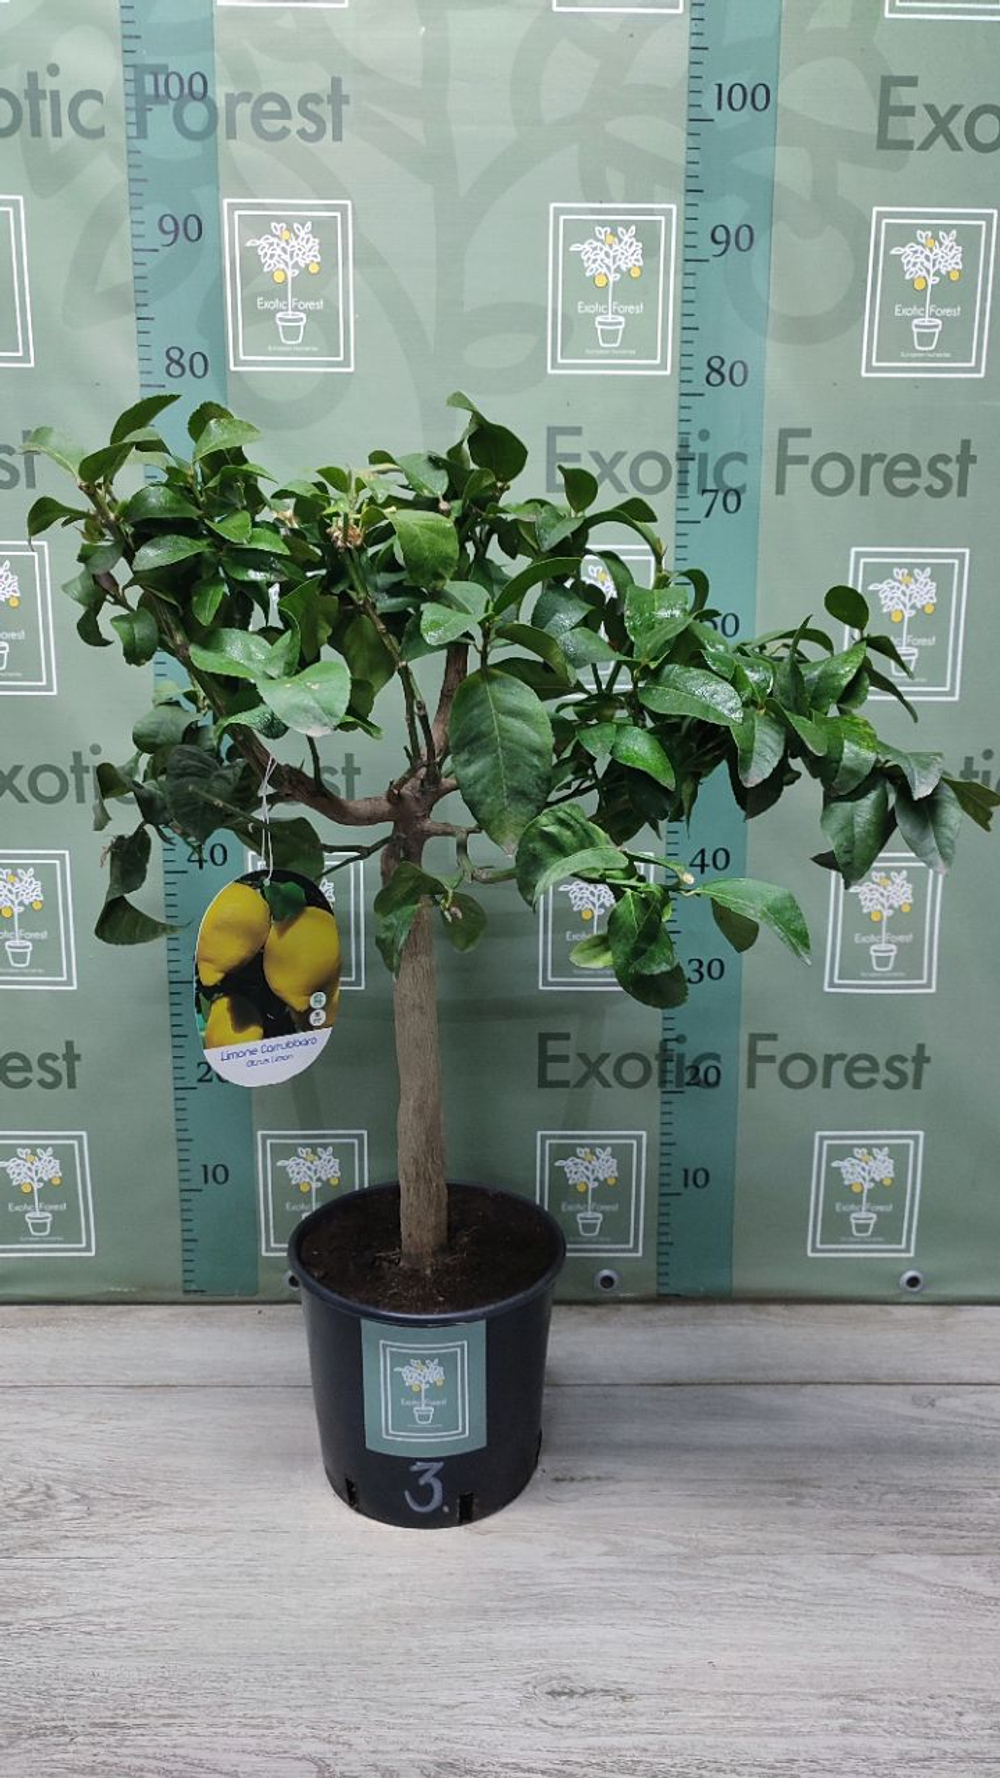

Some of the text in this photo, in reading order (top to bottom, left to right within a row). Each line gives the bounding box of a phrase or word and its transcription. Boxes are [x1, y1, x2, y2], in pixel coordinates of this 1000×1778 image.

[151, 71, 208, 101] 100
[714, 82, 771, 112] 100
[132, 63, 350, 142] Forest
[876, 75, 1000, 153] Exo
[158, 213, 203, 247] 90
[710, 224, 755, 258] 90
[257, 297, 324, 310] Exotic Forest
[577, 301, 644, 314] Exotic Forest
[894, 304, 961, 317] Exotic Forest
[165, 345, 210, 379] 80
[705, 355, 749, 388] 80
[545, 426, 978, 499] Exotic Forest
[701, 488, 742, 519] 70
[186, 842, 229, 870] 40
[689, 847, 730, 874] 40
[687, 957, 725, 984] 30
[220, 1047, 258, 1062] Limone
[537, 1032, 931, 1090] Exotic Forest
[685, 1064, 722, 1087] 20
[202, 1164, 229, 1186] 10
[682, 1167, 711, 1189] 10
